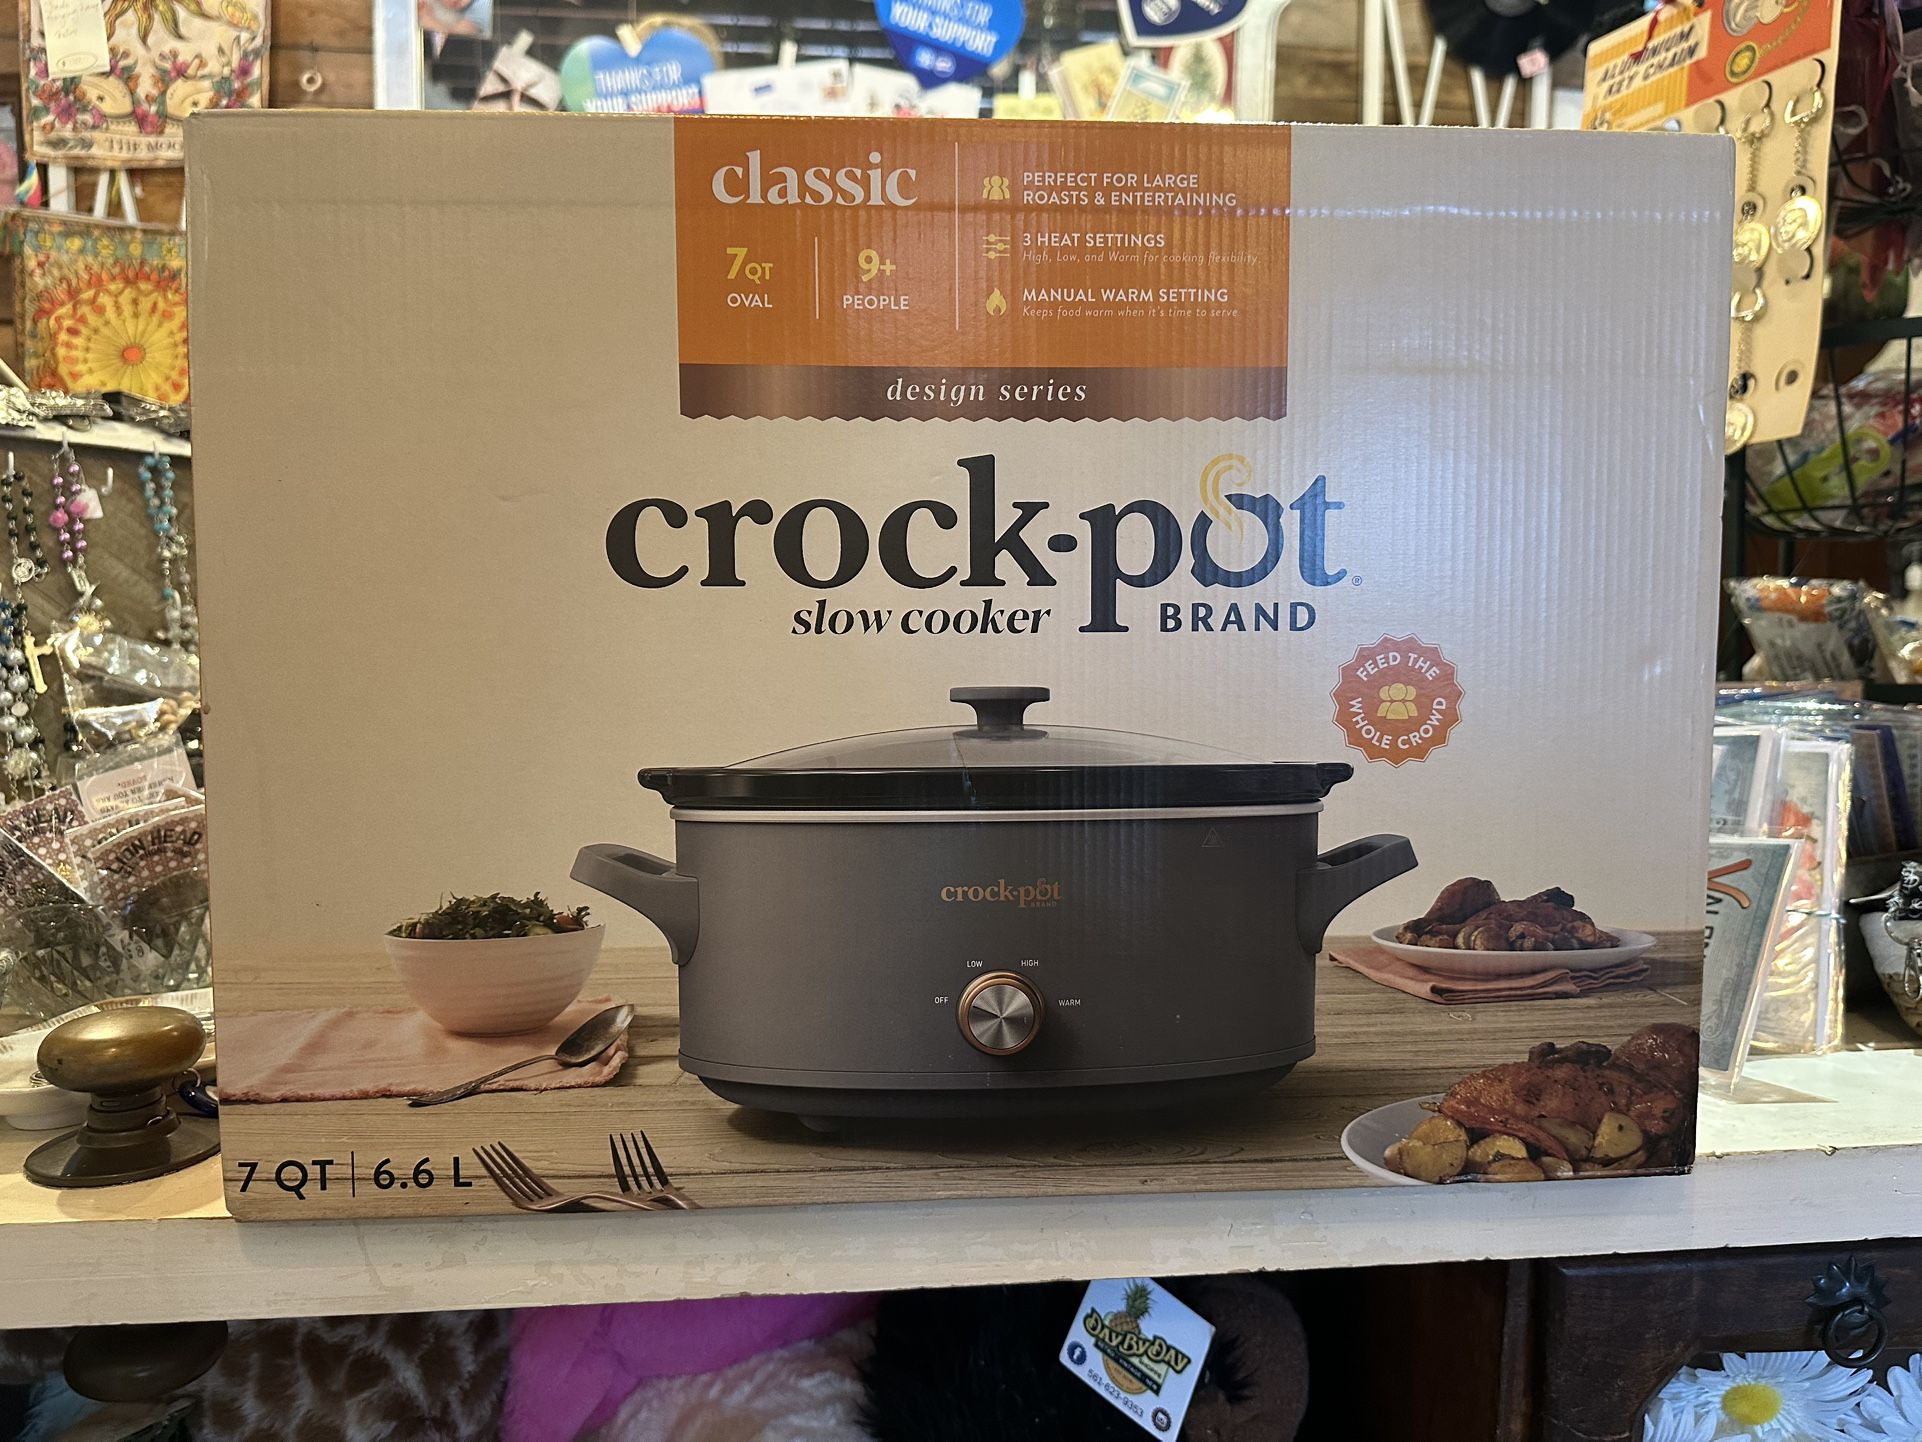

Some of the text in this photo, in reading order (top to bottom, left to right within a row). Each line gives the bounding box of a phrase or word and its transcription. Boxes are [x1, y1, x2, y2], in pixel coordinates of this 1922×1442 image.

[929, 15, 1000, 57] SUPPORT
[1641, 41, 1699, 82] CHAIN
[594, 64, 653, 94] THANKS
[711, 149, 919, 207] classic
[1022, 172, 1199, 188] PERFECT FOR LARGE
[1022, 190, 1237, 207] ROASTS & ENTERTAINING
[1022, 233, 1166, 248] 3 HEAT SETTINGS
[725, 247, 774, 285] 7QT
[857, 248, 897, 283] 9+
[1022, 250, 1052, 264] High,
[1056, 250, 1081, 263] Low,
[1084, 250, 1105, 262] and
[1108, 250, 1140, 262] Warm
[1143, 250, 1159, 266] for
[1162, 251, 1204, 266] cooking
[726, 292, 774, 308] OVAL
[842, 295, 910, 310] PEOPLE
[1022, 288, 1229, 303] MANUAL WARM SETTING
[1022, 306, 1054, 320] Keeps
[1057, 306, 1082, 319] food
[1085, 309, 1114, 317] warm
[1117, 306, 1145, 317] when
[1148, 306, 1165, 317] it's
[1168, 306, 1192, 317] time
[1196, 308, 1207, 317] to
[886, 378, 1088, 408] design series
[791, 598, 1052, 635] slow cooker
[1159, 601, 1318, 633] BRAND
[1355, 651, 1441, 681] FEED THE
[1348, 697, 1447, 750] WHOLE CROWD
[150, 828, 203, 847] HEAD
[966, 959, 1039, 968] LOW HIGH
[934, 996, 949, 1004] OFF
[237, 1156, 473, 1201] 7 QT 6.6 L
